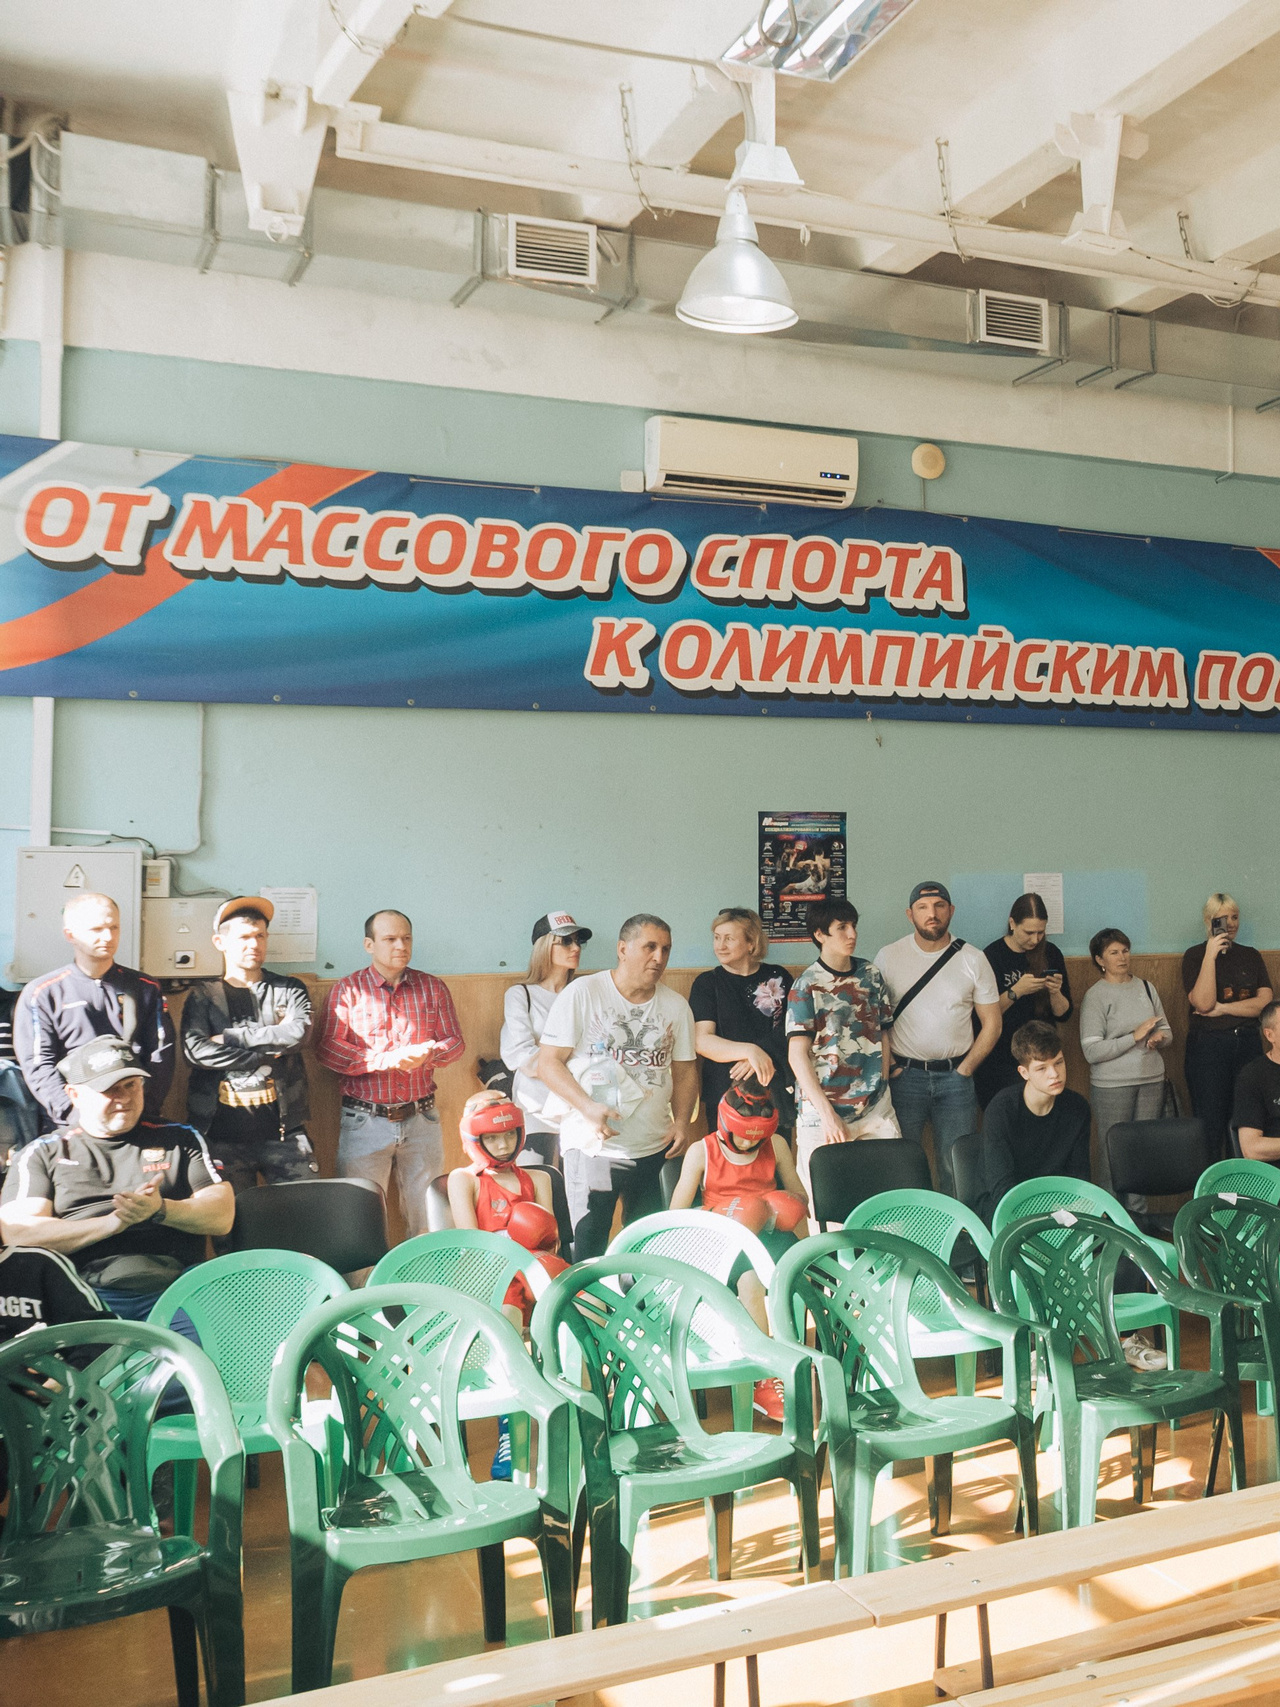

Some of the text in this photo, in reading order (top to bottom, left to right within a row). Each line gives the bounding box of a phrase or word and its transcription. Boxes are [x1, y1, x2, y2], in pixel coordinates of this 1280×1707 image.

[20, 485, 958, 606] ОТ МАССОВОГО СПОРТА
[587, 619, 648, 682] К
[661, 622, 1182, 701] ОЛИМПИЙСКИМ
